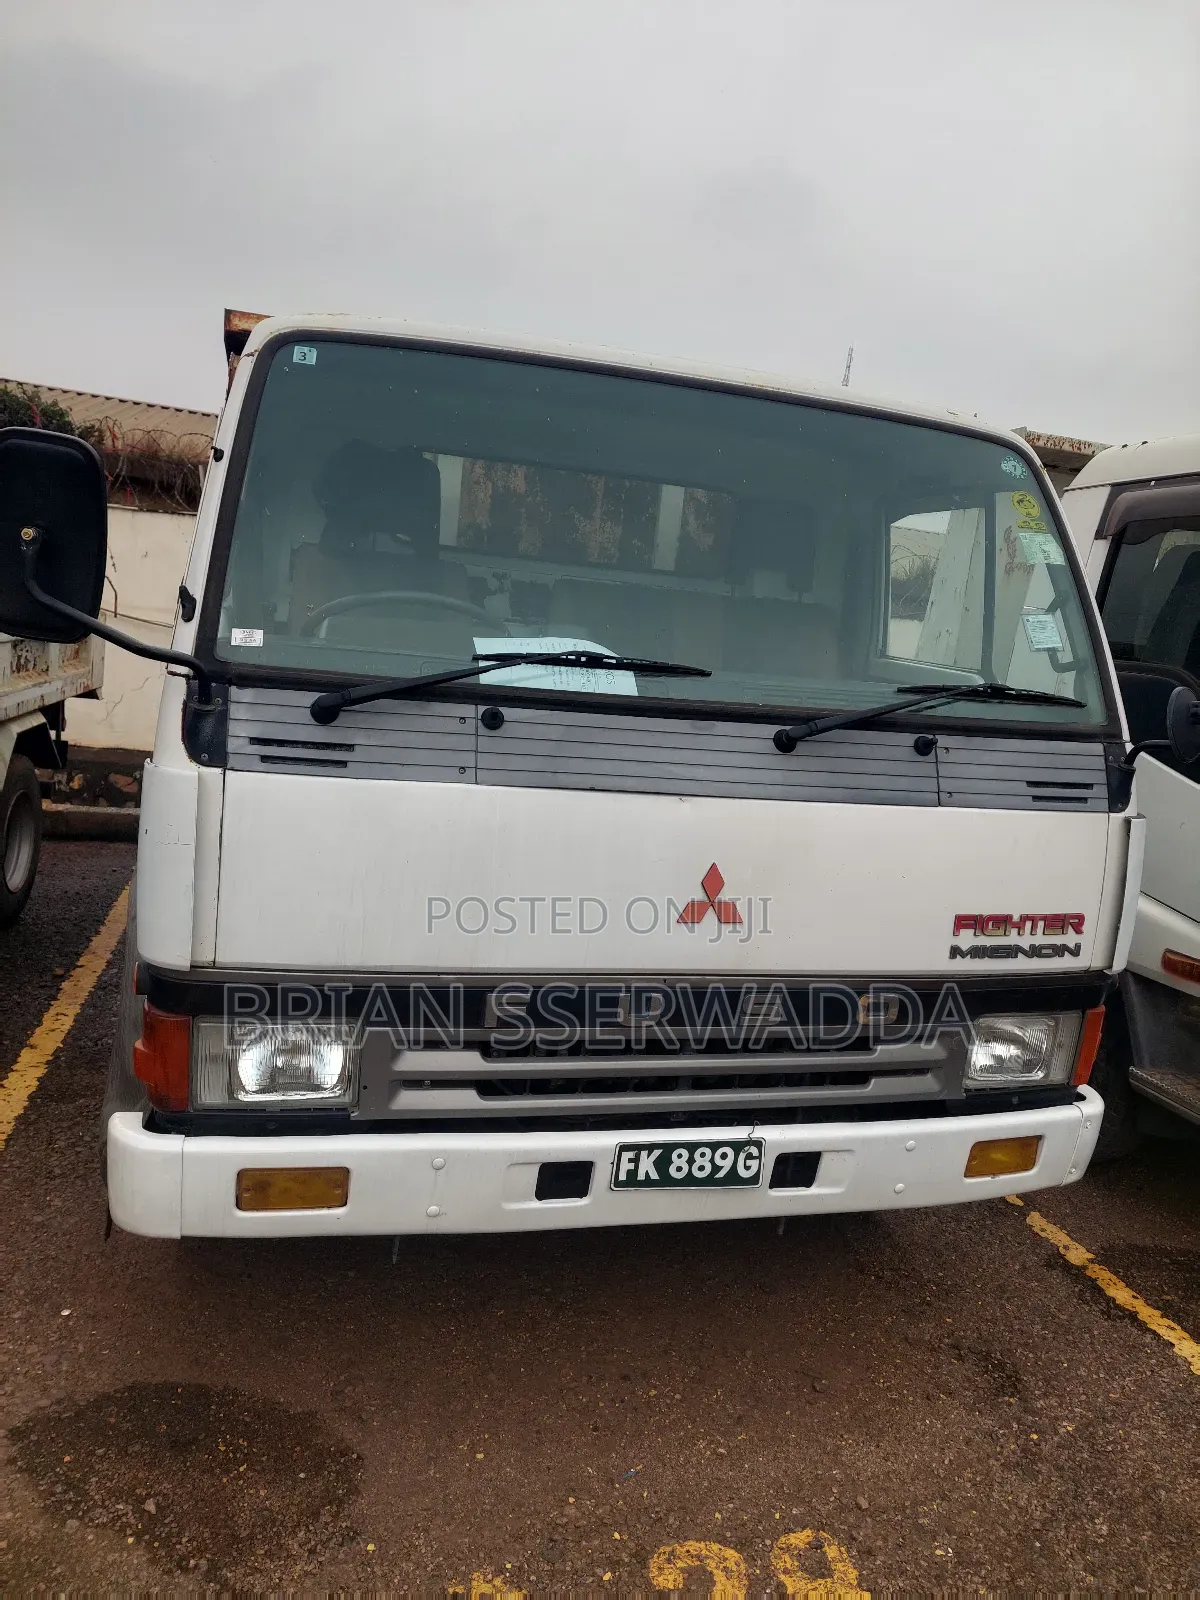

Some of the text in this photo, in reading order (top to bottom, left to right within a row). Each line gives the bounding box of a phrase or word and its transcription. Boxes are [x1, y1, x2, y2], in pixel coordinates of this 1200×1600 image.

[298, 351, 307, 361] 3
[952, 913, 1085, 937] FIGHTER
[949, 943, 1082, 960] MIGNON
[618, 1146, 760, 1181] FK 889G
